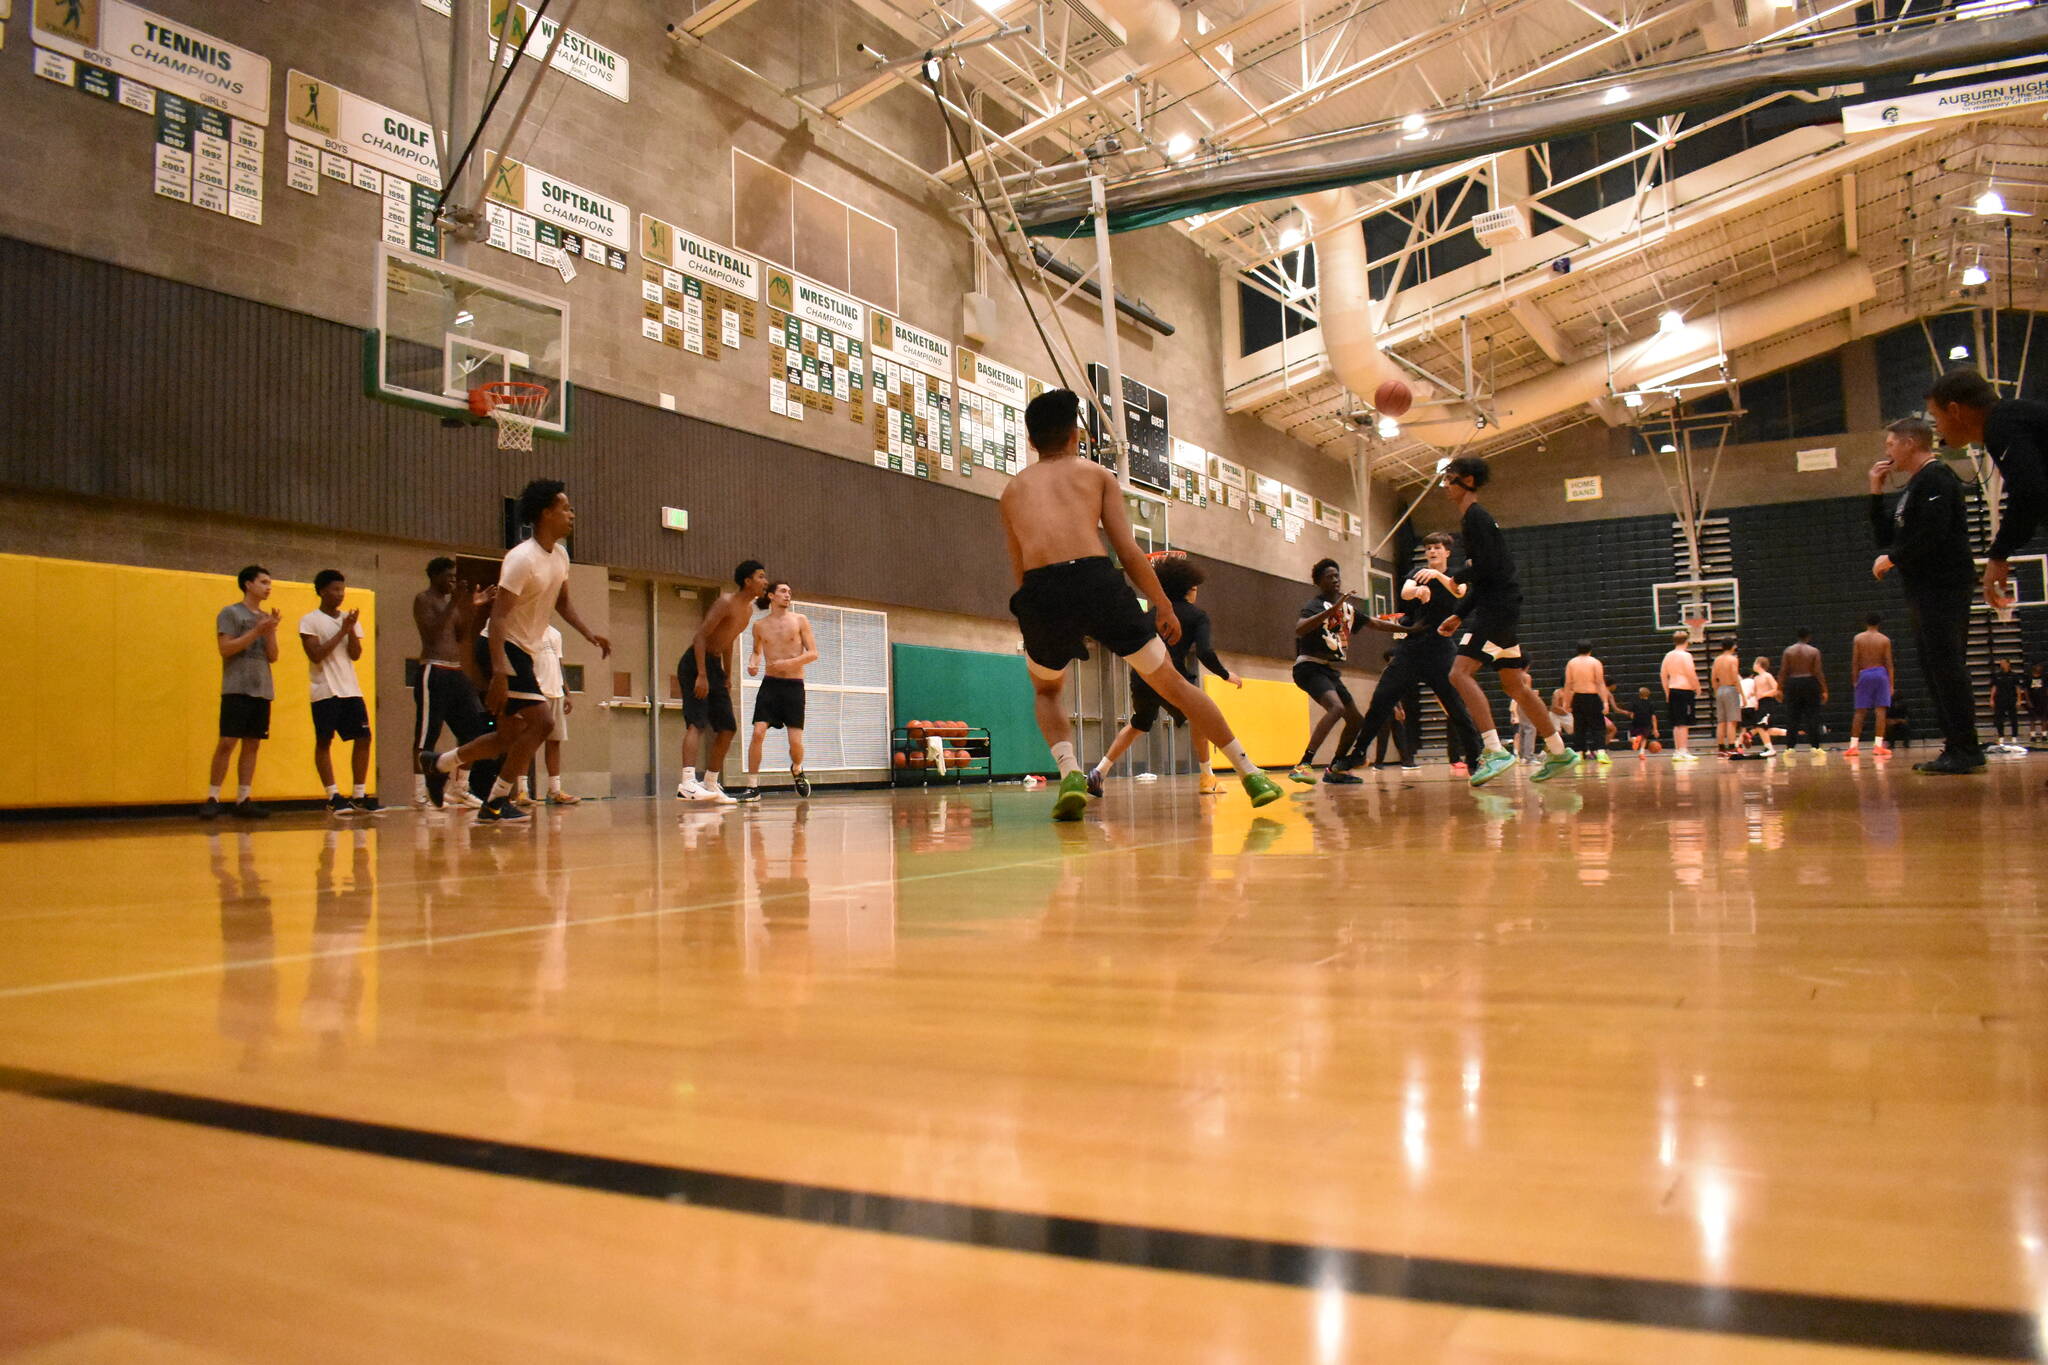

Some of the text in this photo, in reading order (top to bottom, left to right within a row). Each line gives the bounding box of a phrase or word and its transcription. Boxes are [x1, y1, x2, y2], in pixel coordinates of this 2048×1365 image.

[83, 49, 113, 68] BOYS
[144, 20, 232, 71] TENNIS
[129, 44, 244, 94] CHAMPIONS
[200, 92, 229, 110] GIRLS
[1938, 87, 2004, 106] AUBURN
[325, 138, 349, 154] BOYS
[384, 116, 429, 148] GOLF
[361, 132, 440, 171] CHAMPION
[416, 173, 440, 188] GIRLS
[541, 181, 615, 223] SOFTBALL
[543, 202, 614, 238] CHAMPIONS
[679, 236, 752, 278] VOLLEYBALL
[688, 259, 745, 289] CHAMPIONS
[800, 286, 858, 321] WRESTLING
[805, 306, 853, 331] CHAMPIONS
[895, 325, 949, 358] BASKETBALL
[902, 344, 942, 367] CHAMPIONS
[977, 362, 1024, 390] BASKETBALL
[985, 377, 1017, 394] CHAMPIONS
[1151, 415, 1165, 429] GUEST
[1571, 480, 1596, 489] HOME
